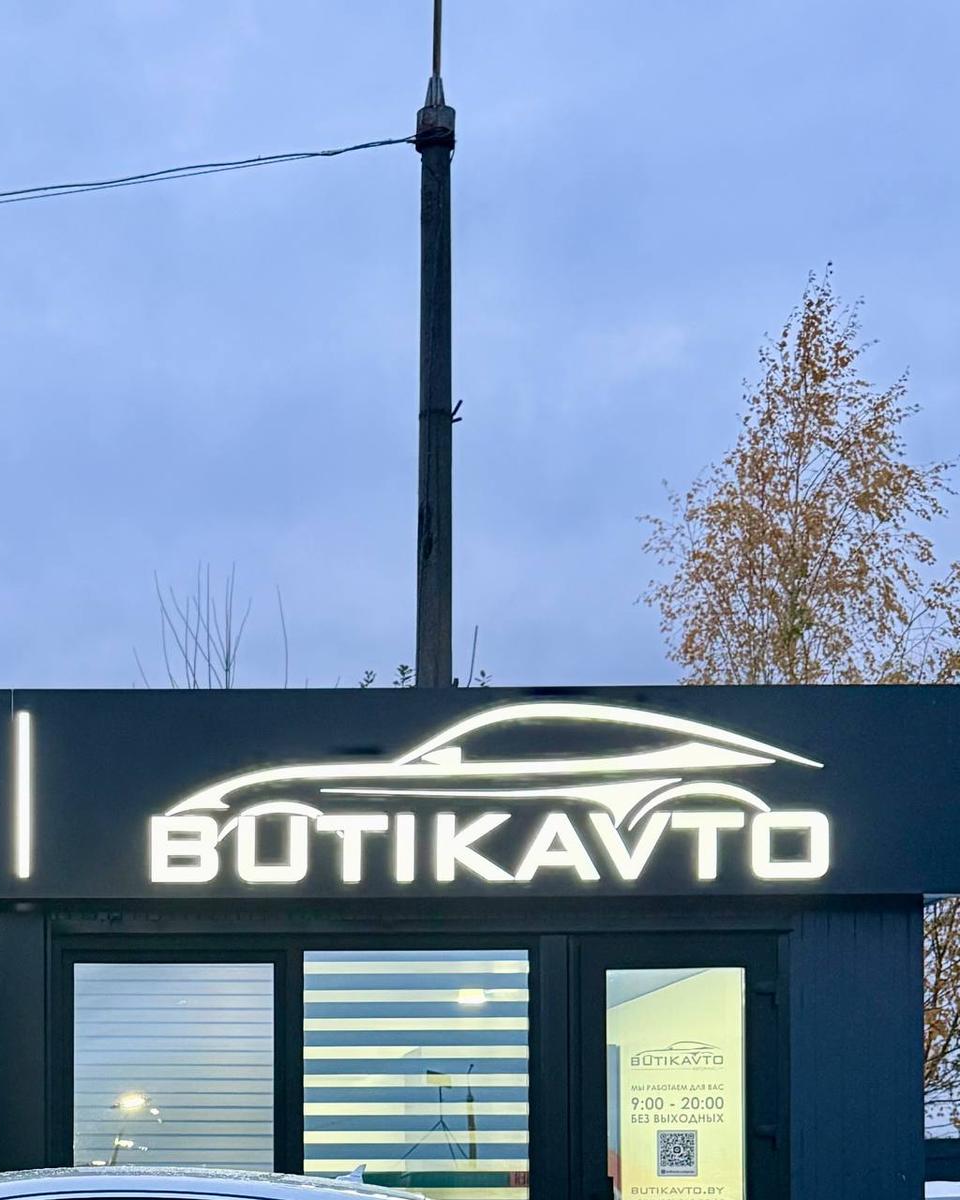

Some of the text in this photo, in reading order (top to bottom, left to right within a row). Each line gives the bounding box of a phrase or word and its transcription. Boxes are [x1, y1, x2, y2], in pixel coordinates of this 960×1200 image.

[149, 810, 831, 884] BUTIKAVTO
[630, 1055, 724, 1066] BUTIKAVTO
[707, 1083, 725, 1091] ВАС
[631, 1096, 664, 1110] 9:00
[680, 1096, 725, 1110] 20:00
[631, 1113, 725, 1124] БЕЗ ВЫХОДНЫХ
[631, 1186, 725, 1195] BUTIKAVTO.BY
